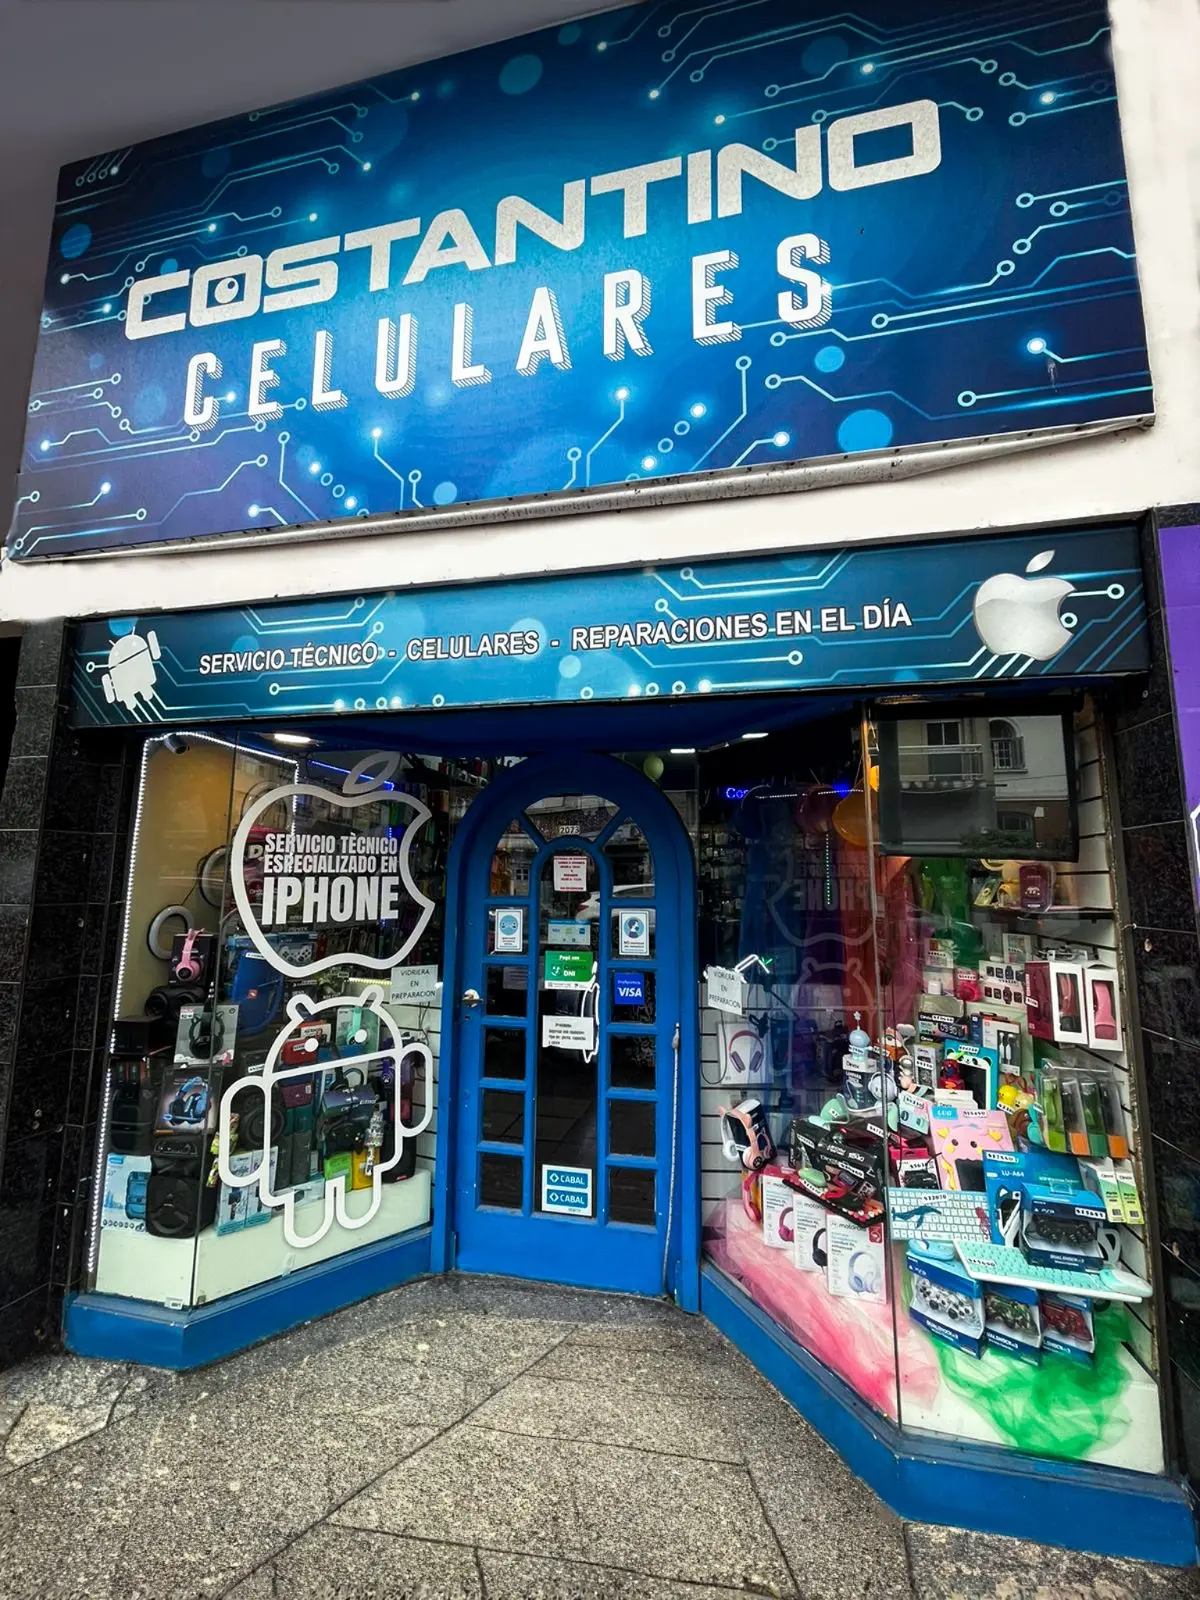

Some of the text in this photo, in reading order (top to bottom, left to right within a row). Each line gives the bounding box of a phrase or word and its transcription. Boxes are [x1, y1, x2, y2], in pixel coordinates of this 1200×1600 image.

[124, 98, 941, 341] COSTANTINO
[183, 232, 834, 432] CELULARES
[199, 649, 286, 676] SERVICIO
[290, 642, 380, 668] TÉCNICO
[407, 631, 540, 661] CELULARES
[571, 609, 768, 652] REPARACIONES
[774, 608, 812, 635] EN
[821, 607, 856, 632] EL
[862, 598, 913, 629] DÍA
[559, 825, 580, 835] 2073
[264, 833, 336, 855] SERVICIO
[264, 855, 398, 873] ESPECIALIZADO EN
[261, 876, 400, 926] IPHONE
[617, 987, 643, 998] VISA
[560, 1175, 585, 1185] CABAL
[560, 1194, 585, 1205] CABAL
